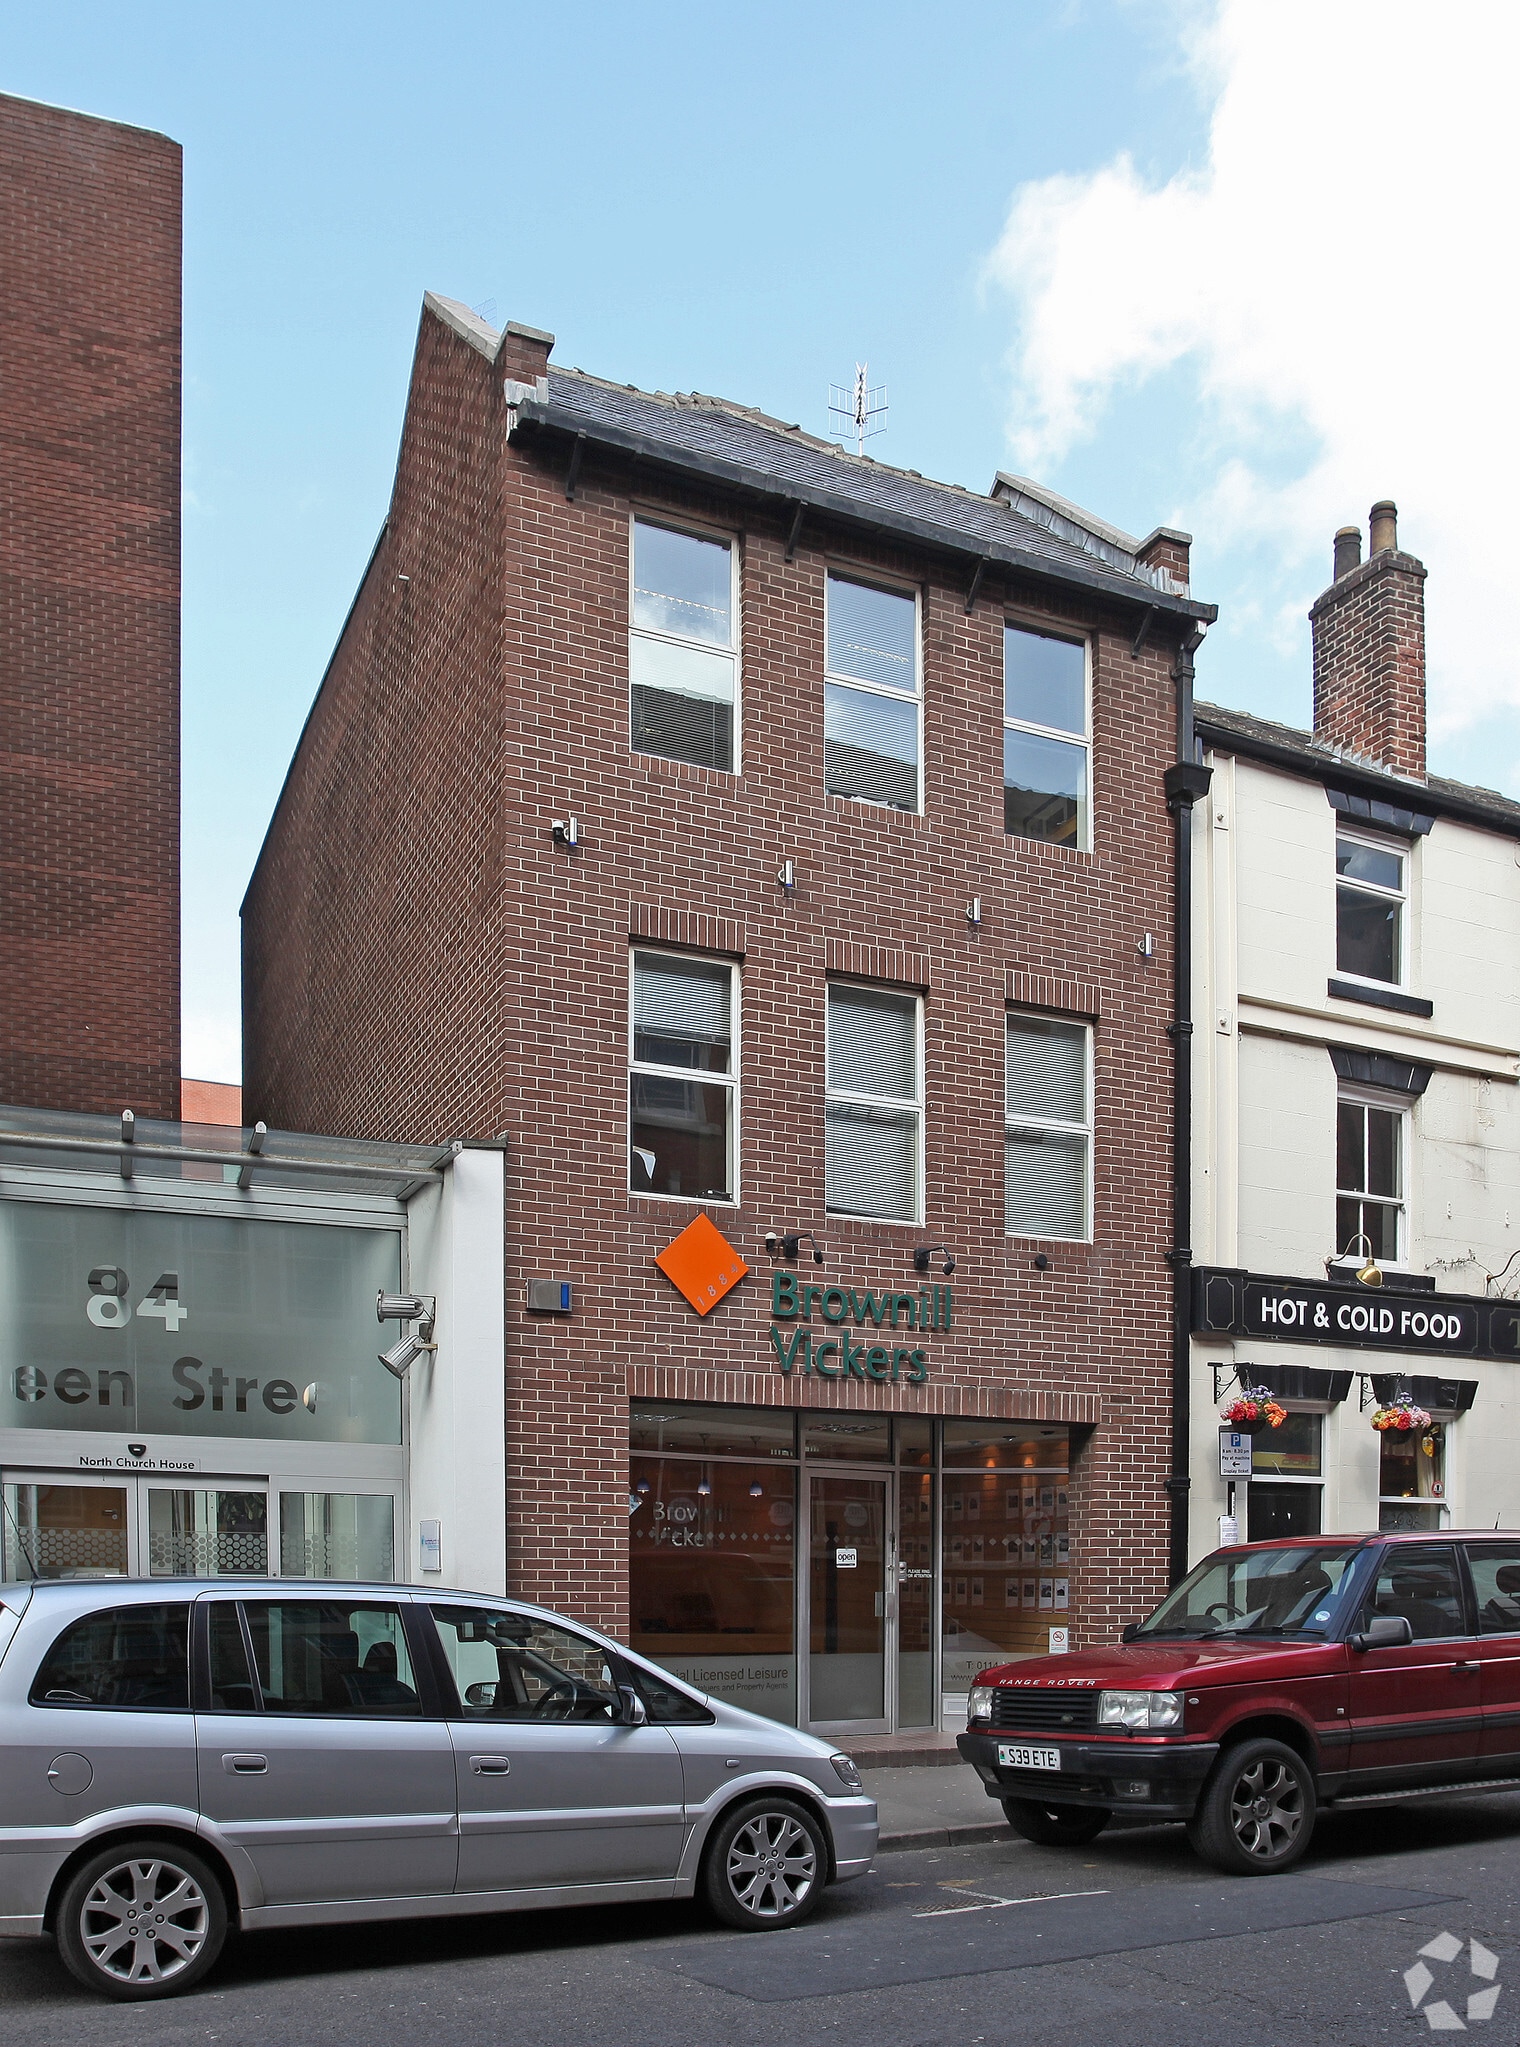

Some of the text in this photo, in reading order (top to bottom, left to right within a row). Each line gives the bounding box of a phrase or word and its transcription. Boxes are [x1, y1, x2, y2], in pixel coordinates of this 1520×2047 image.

[86, 1264, 188, 1333] 84
[771, 1271, 952, 1330] Brownill
[1261, 1297, 1462, 1340] HOT & COLD FOOD
[769, 1326, 928, 1382] Vickers
[79, 1456, 195, 1470] North Church House
[837, 1553, 856, 1562] open
[692, 1667, 745, 1682] Licensed
[747, 1666, 789, 1680] Leisure
[721, 1683, 735, 1691] and
[736, 1682, 765, 1692] Property
[765, 1681, 788, 1691] Agents
[1008, 1748, 1056, 1767] S39 ETE
